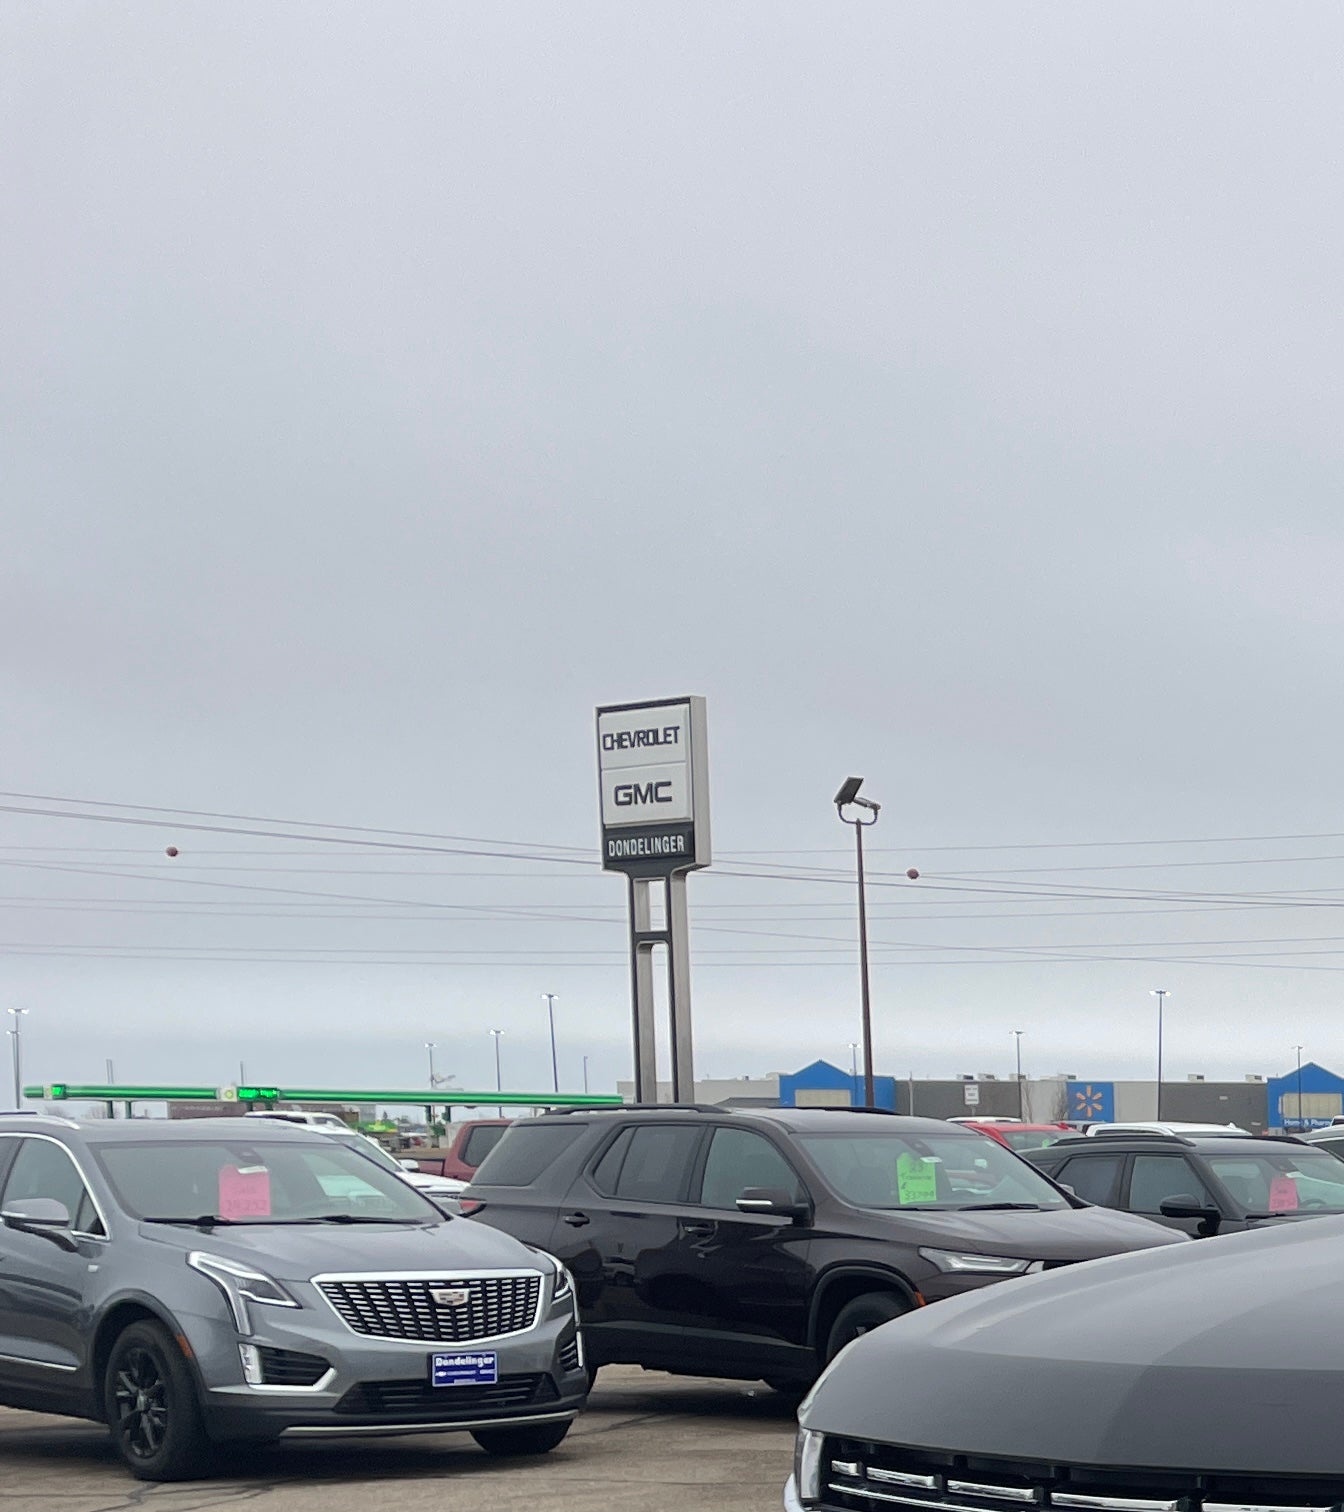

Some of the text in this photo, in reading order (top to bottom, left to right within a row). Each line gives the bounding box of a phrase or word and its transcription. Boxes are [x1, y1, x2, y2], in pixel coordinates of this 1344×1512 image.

[602, 726, 680, 751] CHEVROLET
[614, 781, 673, 806] GMC
[608, 835, 685, 857] DONDELINGER
[435, 1356, 494, 1368] Dondelinger
